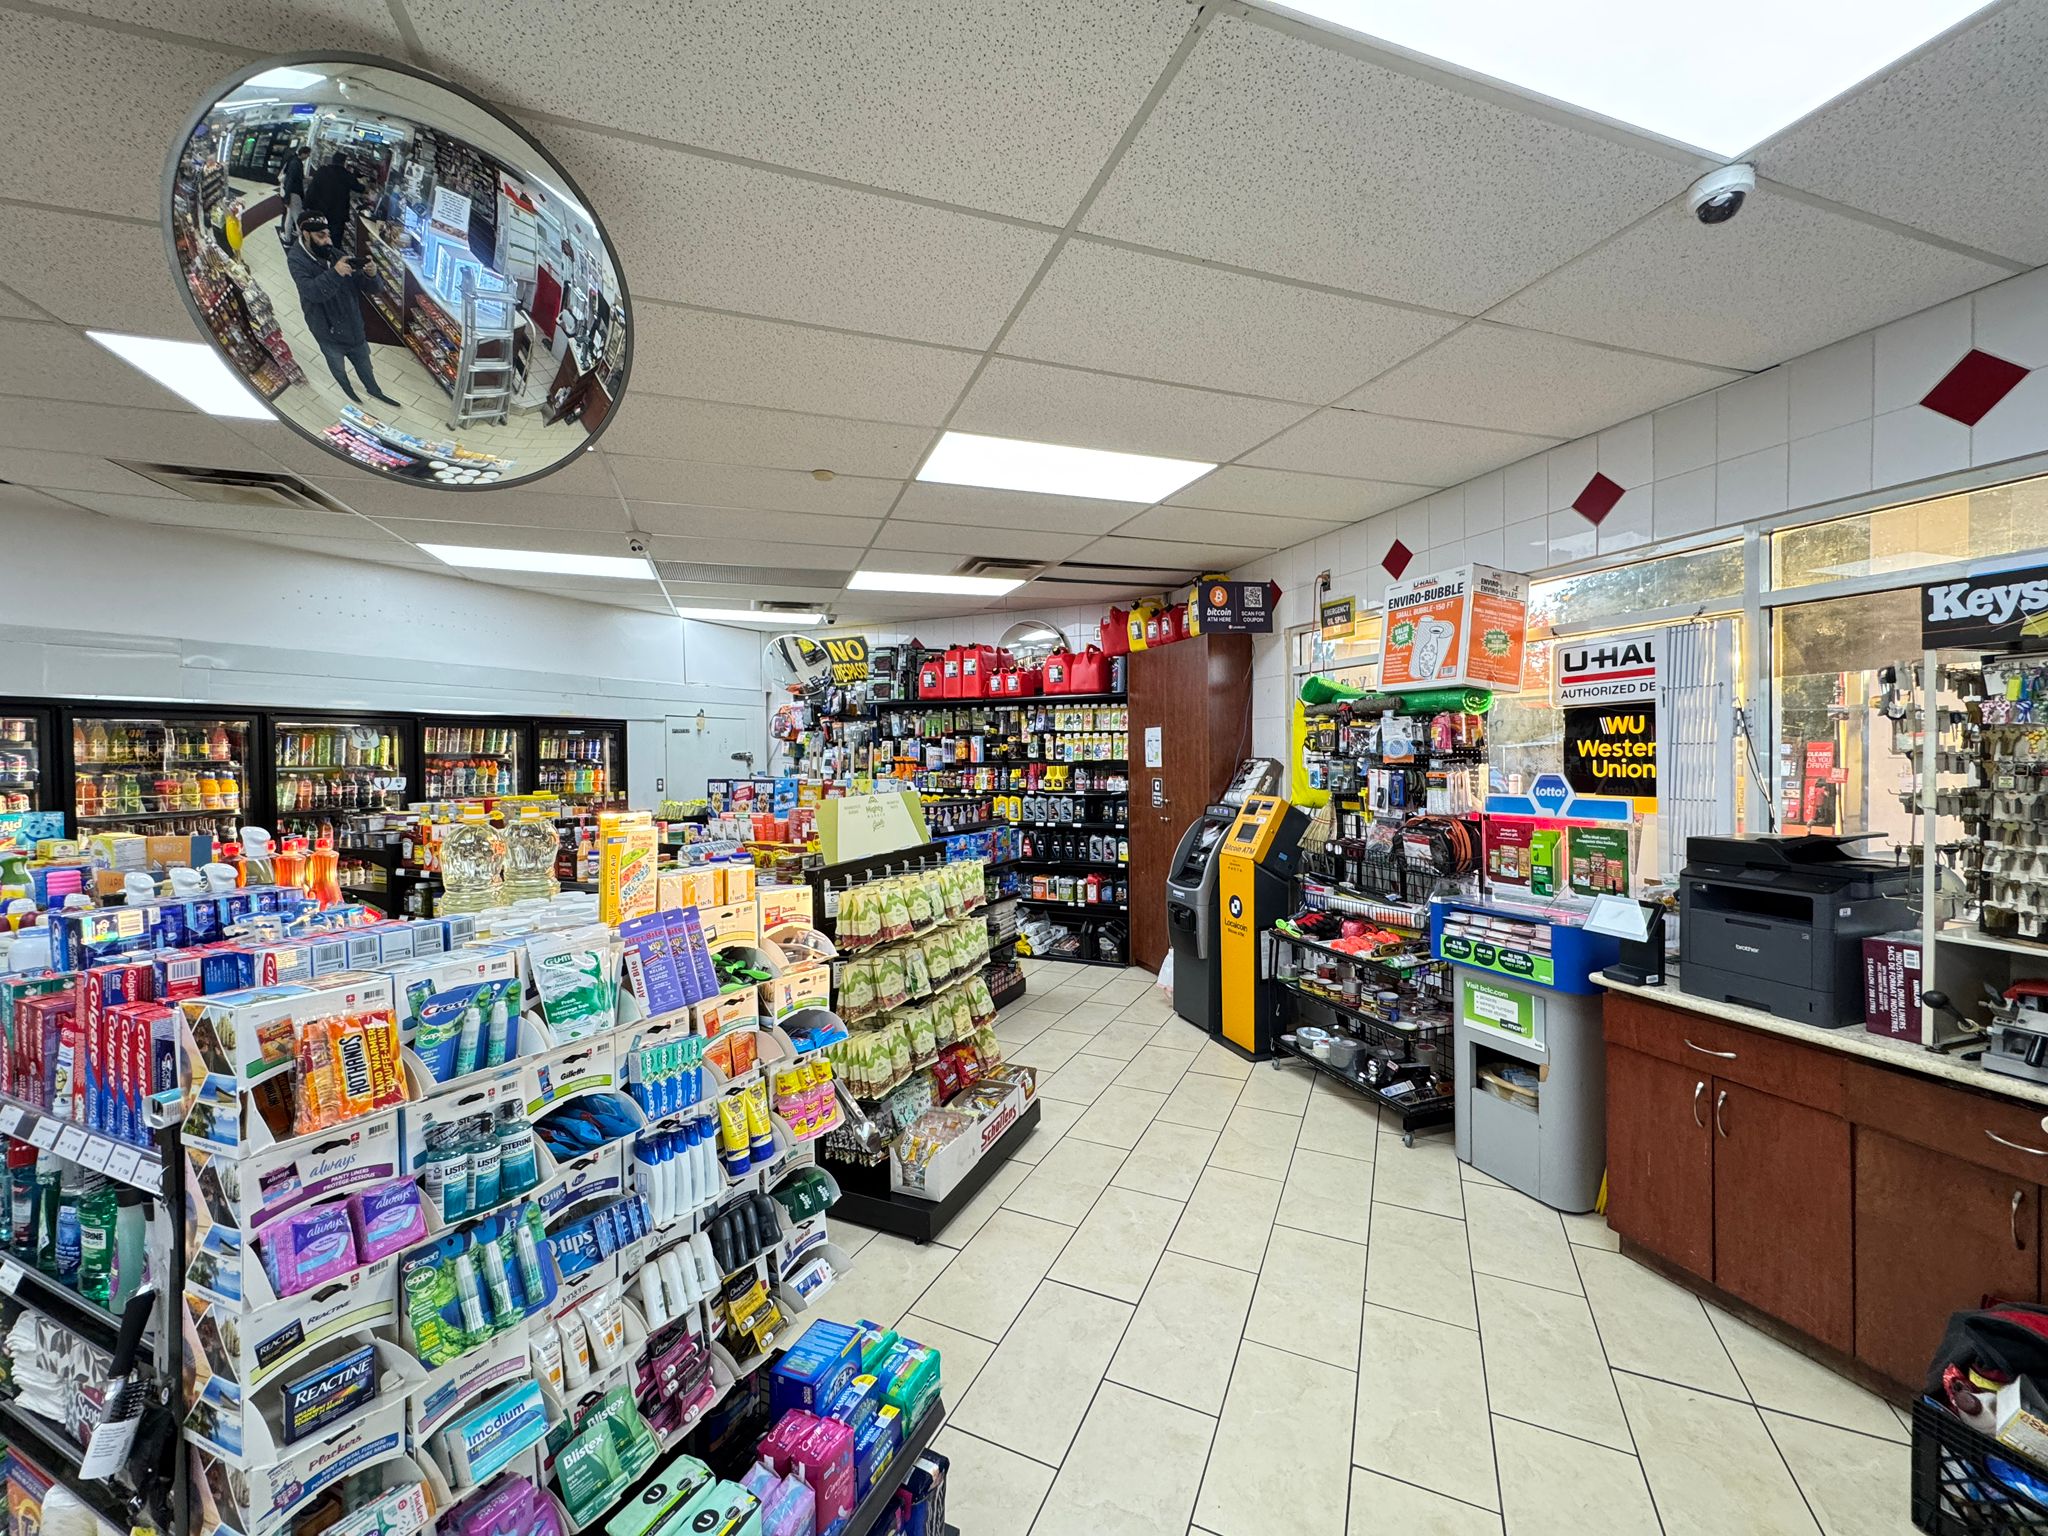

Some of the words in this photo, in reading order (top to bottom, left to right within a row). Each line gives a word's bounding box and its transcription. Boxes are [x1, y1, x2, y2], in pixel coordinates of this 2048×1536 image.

[1388, 582, 1464, 610] ENVIRO-BUBBLE
[1928, 580, 2048, 624] Keys
[1207, 608, 1232, 616] bitcoin
[1396, 610, 1413, 619] SMALL
[826, 640, 864, 662] NO
[832, 662, 868, 681] TRESPASS
[1561, 682, 1636, 699] AUTHORIZED
[1602, 714, 1645, 734] WU
[1592, 758, 1656, 778] Union
[1535, 785, 1566, 797] lotto!
[1224, 844, 1242, 852] Bitcoin
[1242, 846, 1255, 854] ATM
[1735, 944, 1760, 954] brother
[1887, 945, 1895, 962] SACS
[1889, 962, 1895, 970] DE
[1896, 952, 1904, 987] INDUSTRIAL
[127, 969, 136, 1002] Colgate
[630, 961, 640, 977] Bite
[635, 977, 645, 998] After
[1465, 981, 1479, 990] Visit
[1889, 972, 1897, 999] FORMAT
[422, 998, 468, 1017] Crest
[1897, 988, 1905, 1008] DRUM
[88, 977, 99, 1067] Colgate
[1890, 1000, 1899, 1032] INDUSTRIEL
[1508, 1023, 1528, 1034] more!
[108, 1014, 117, 1089] Colgate
[121, 1019, 130, 1094] Colgate
[366, 1024, 381, 1071] WARMERS
[137, 1023, 147, 1097] Colgate
[339, 1034, 370, 1098] HOTHANDS
[374, 1072, 385, 1098] HAND
[560, 1067, 586, 1081] Gillette
[780, 1109, 798, 1119] Pepto
[500, 1135, 532, 1151] ISTERINE
[309, 1153, 356, 1178] always
[445, 1162, 467, 1176] LISTE
[477, 1154, 500, 1167] LISTE
[330, 1172, 349, 1182] PANTY
[350, 1168, 370, 1177] LINERS
[375, 1188, 411, 1210] always
[82, 1230, 104, 1240] TERINE
[306, 1216, 344, 1239] always
[406, 1270, 434, 1286] scope
[307, 1300, 350, 1325] REACTINE
[259, 1326, 299, 1356] REACTINE
[460, 1359, 490, 1380] Imodium
[294, 1360, 369, 1408] REACTINE
[832, 1386, 855, 1411] TAMPAX
[586, 1396, 625, 1427] Blistex
[468, 1403, 525, 1447] Imodium
[856, 1425, 876, 1451] TAMPAX
[308, 1434, 362, 1472] Plackers
[339, 1451, 360, 1469] DENTAL
[563, 1434, 604, 1469] Blistex
